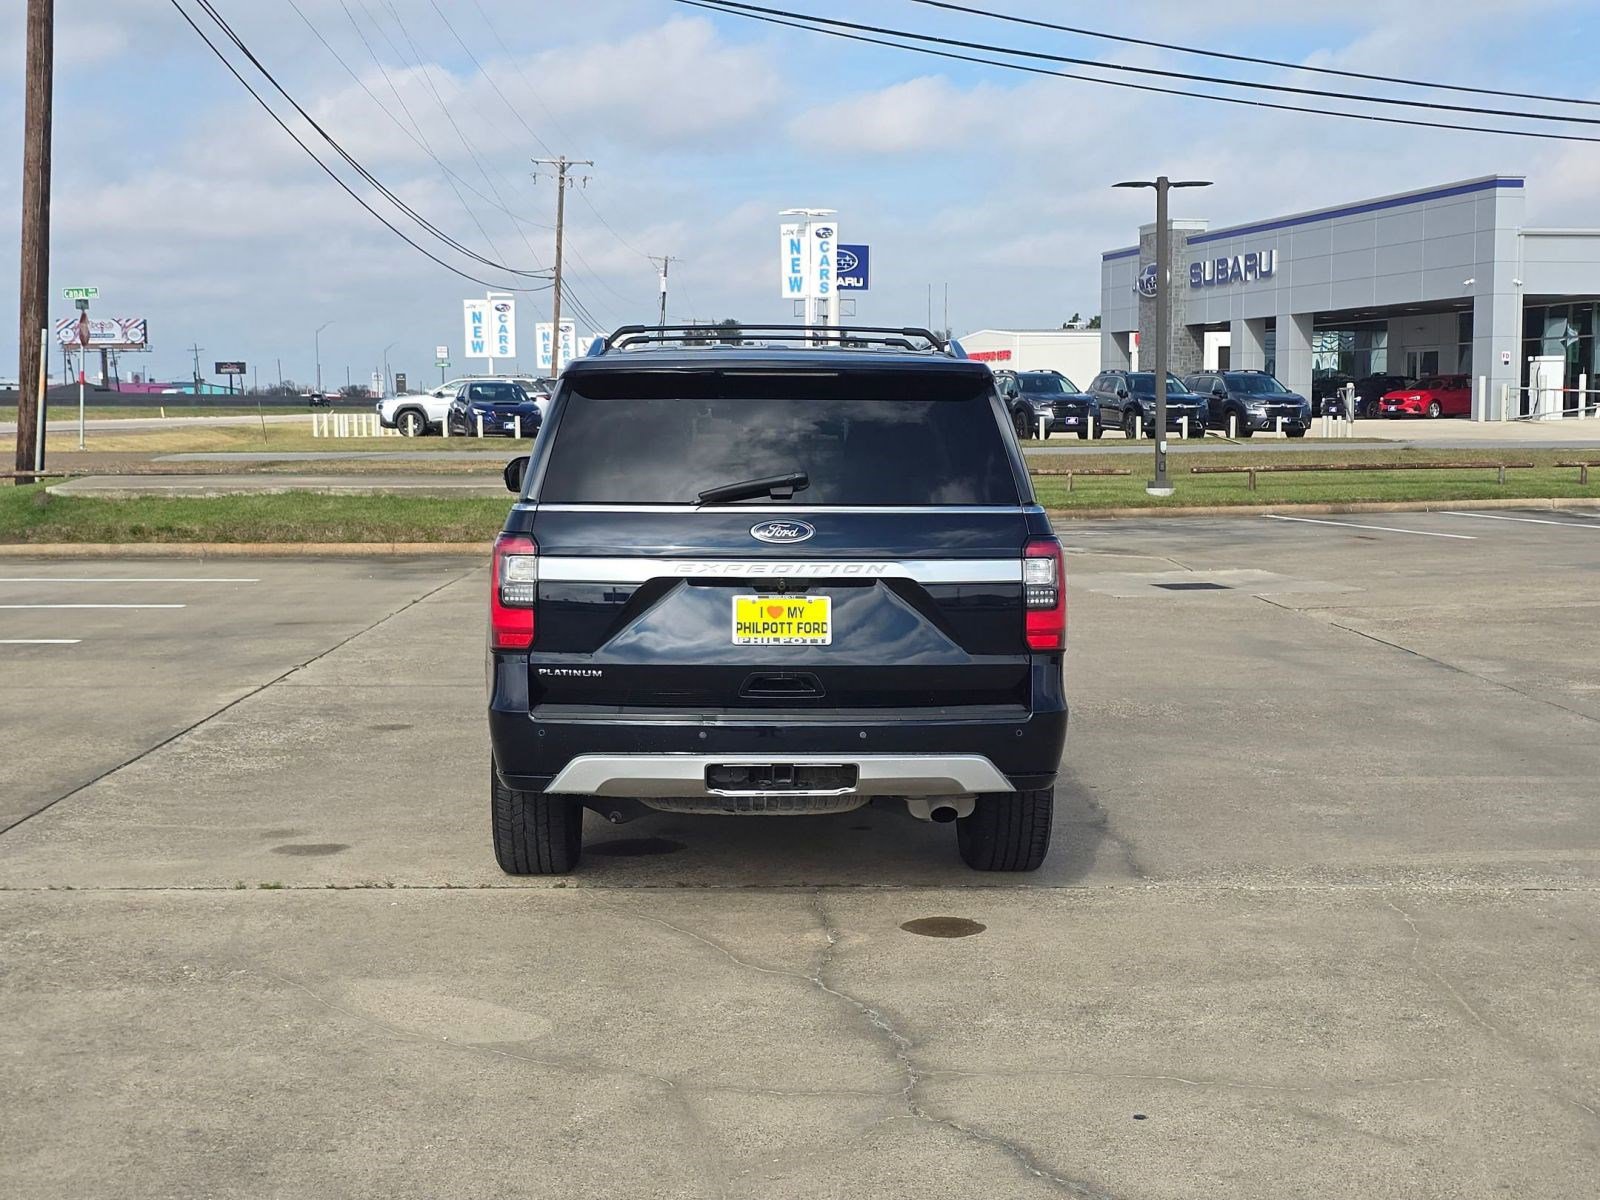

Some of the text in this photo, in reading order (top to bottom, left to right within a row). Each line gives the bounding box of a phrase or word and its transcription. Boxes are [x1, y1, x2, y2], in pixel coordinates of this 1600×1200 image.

[788, 239, 803, 293] NEW
[819, 241, 830, 294] CARS
[1189, 249, 1277, 289] SUBARU
[837, 277, 863, 287] ARU
[64, 289, 87, 298] Canal
[471, 311, 485, 353] NEW
[498, 313, 509, 355] CARS
[541, 331, 552, 365] NEW
[760, 524, 799, 538] Ford
[674, 563, 888, 575] EXPEDITION
[787, 606, 805, 619] MY
[736, 621, 828, 634] PHILPOTT FORD
[538, 668, 603, 678] PLATINUM
